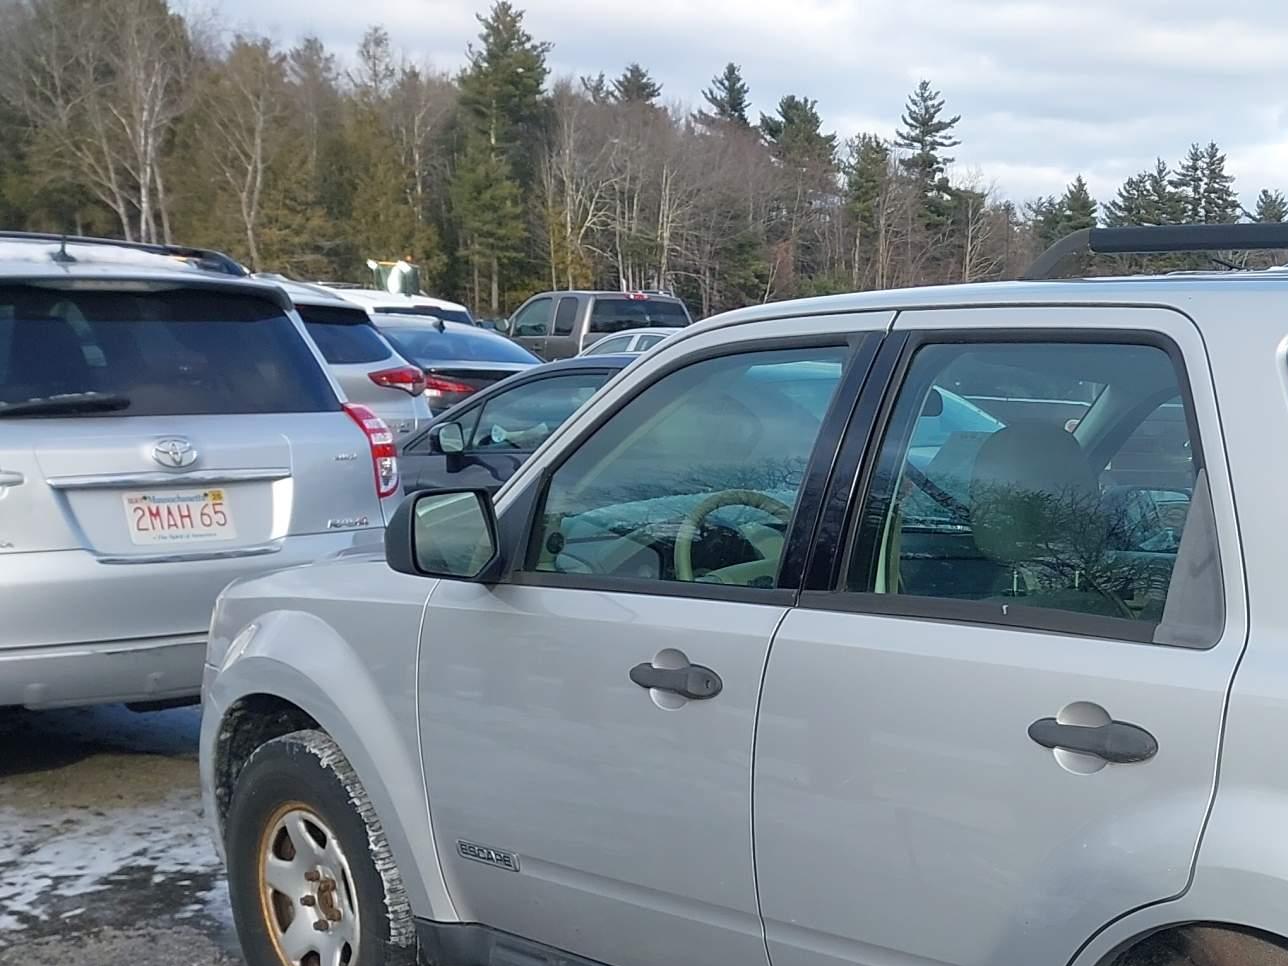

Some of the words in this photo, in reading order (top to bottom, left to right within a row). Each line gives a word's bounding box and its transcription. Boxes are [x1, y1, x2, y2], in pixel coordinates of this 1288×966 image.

[133, 504, 194, 531] 2MAH
[200, 503, 228, 528] 65
[460, 843, 513, 868] ESCAPE
